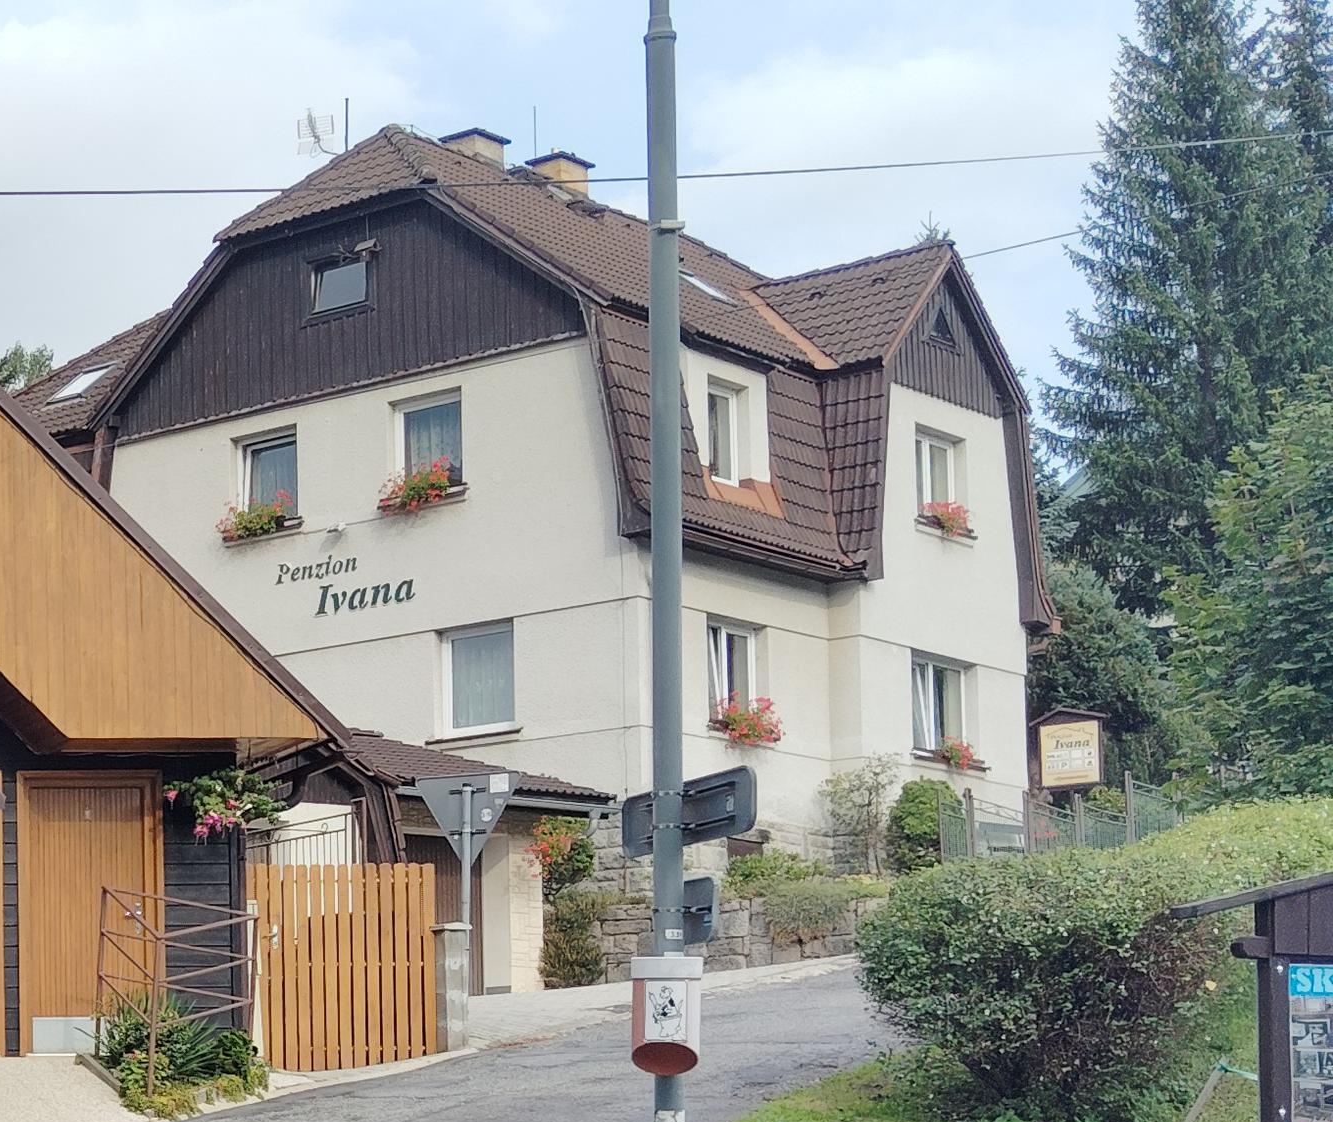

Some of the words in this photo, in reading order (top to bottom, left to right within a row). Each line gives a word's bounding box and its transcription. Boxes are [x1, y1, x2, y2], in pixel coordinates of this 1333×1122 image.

[275, 554, 358, 586] Penzion
[314, 578, 416, 617] Ivana
[1053, 738, 1091, 750] Ivana
